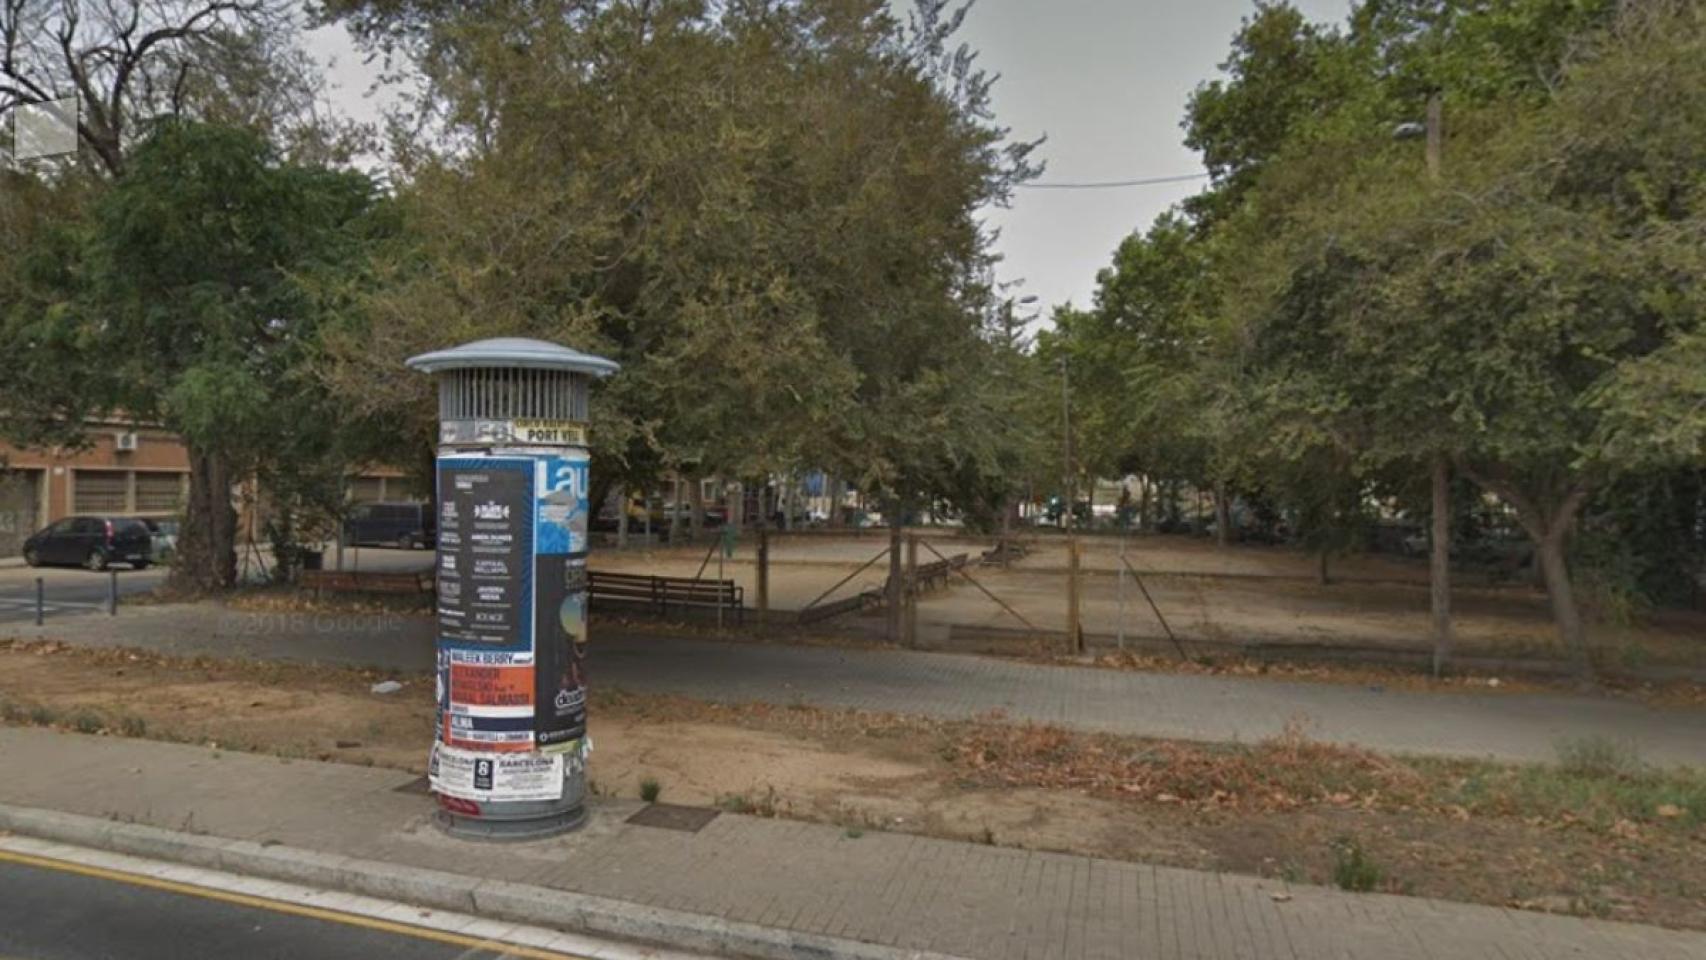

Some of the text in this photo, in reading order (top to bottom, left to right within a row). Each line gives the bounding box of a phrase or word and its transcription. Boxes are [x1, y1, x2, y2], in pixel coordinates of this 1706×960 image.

[528, 429, 557, 441] PORT
[483, 653, 513, 664] BERRY
[478, 761, 488, 775] 8
[499, 758, 554, 768] BARCELONA
